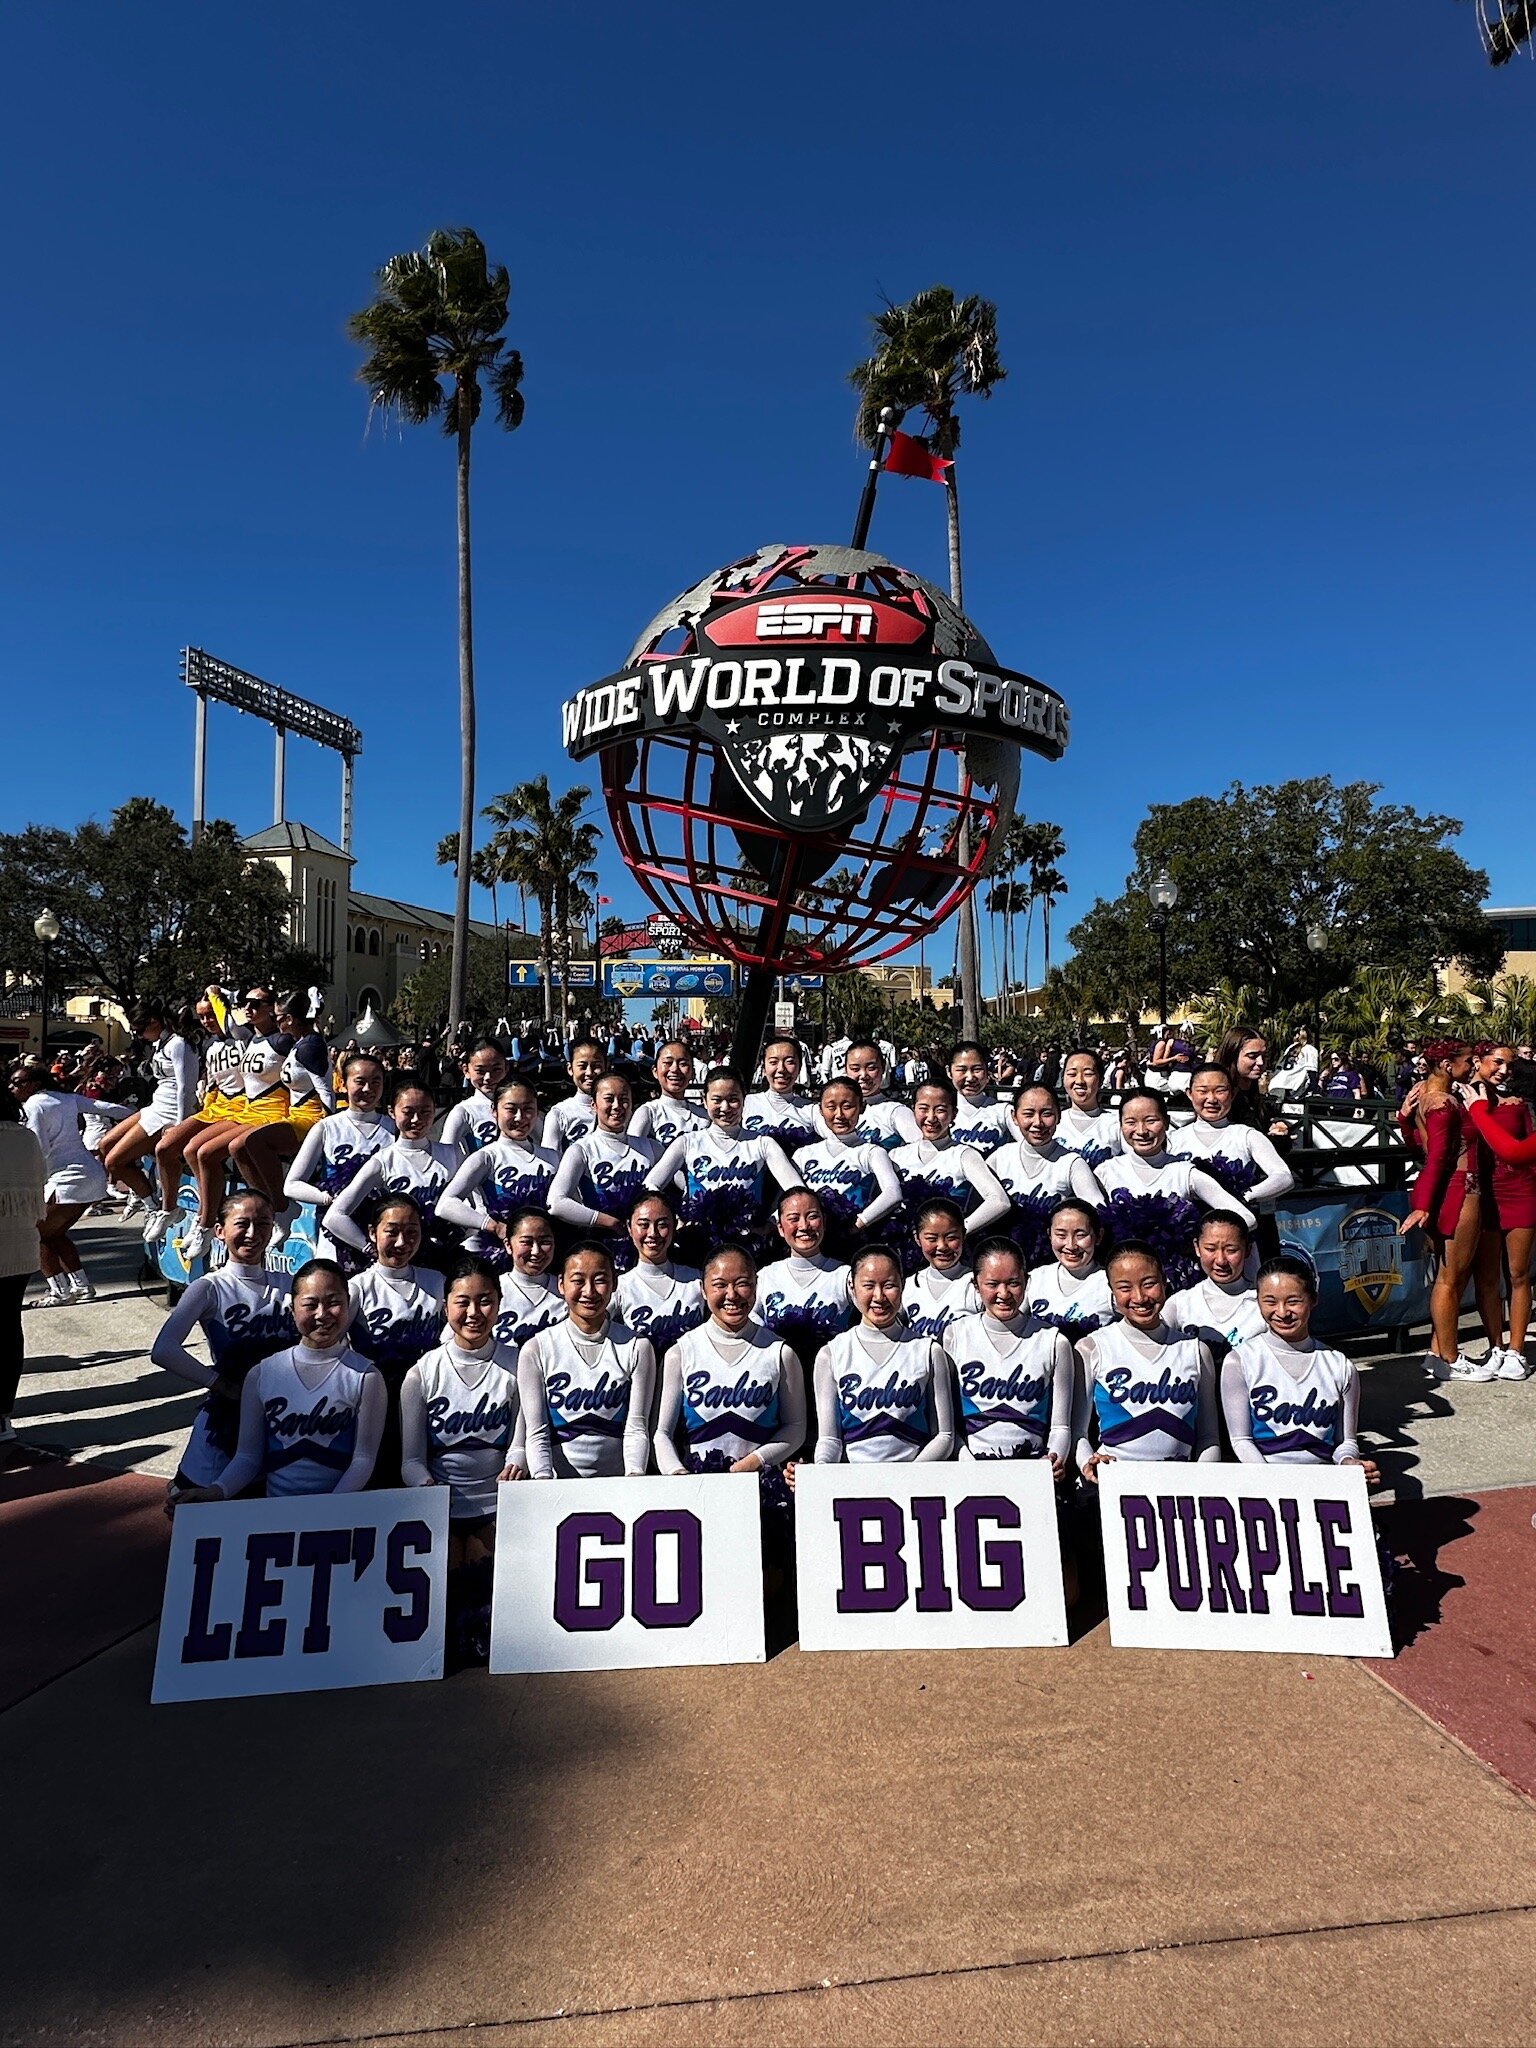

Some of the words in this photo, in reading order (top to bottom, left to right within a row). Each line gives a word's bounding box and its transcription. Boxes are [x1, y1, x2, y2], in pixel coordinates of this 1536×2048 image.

[756, 603, 873, 637] ESPN
[561, 675, 642, 749] WIDE
[648, 656, 861, 717] WORLD
[868, 665, 933, 708] OF
[934, 659, 1071, 748] SPORTS
[757, 712, 867, 727] COMPLEX
[181, 1520, 432, 1664] LET'S
[554, 1509, 703, 1632] GO
[833, 1496, 1026, 1613] BIG
[1119, 1495, 1364, 1617] PURPLE
